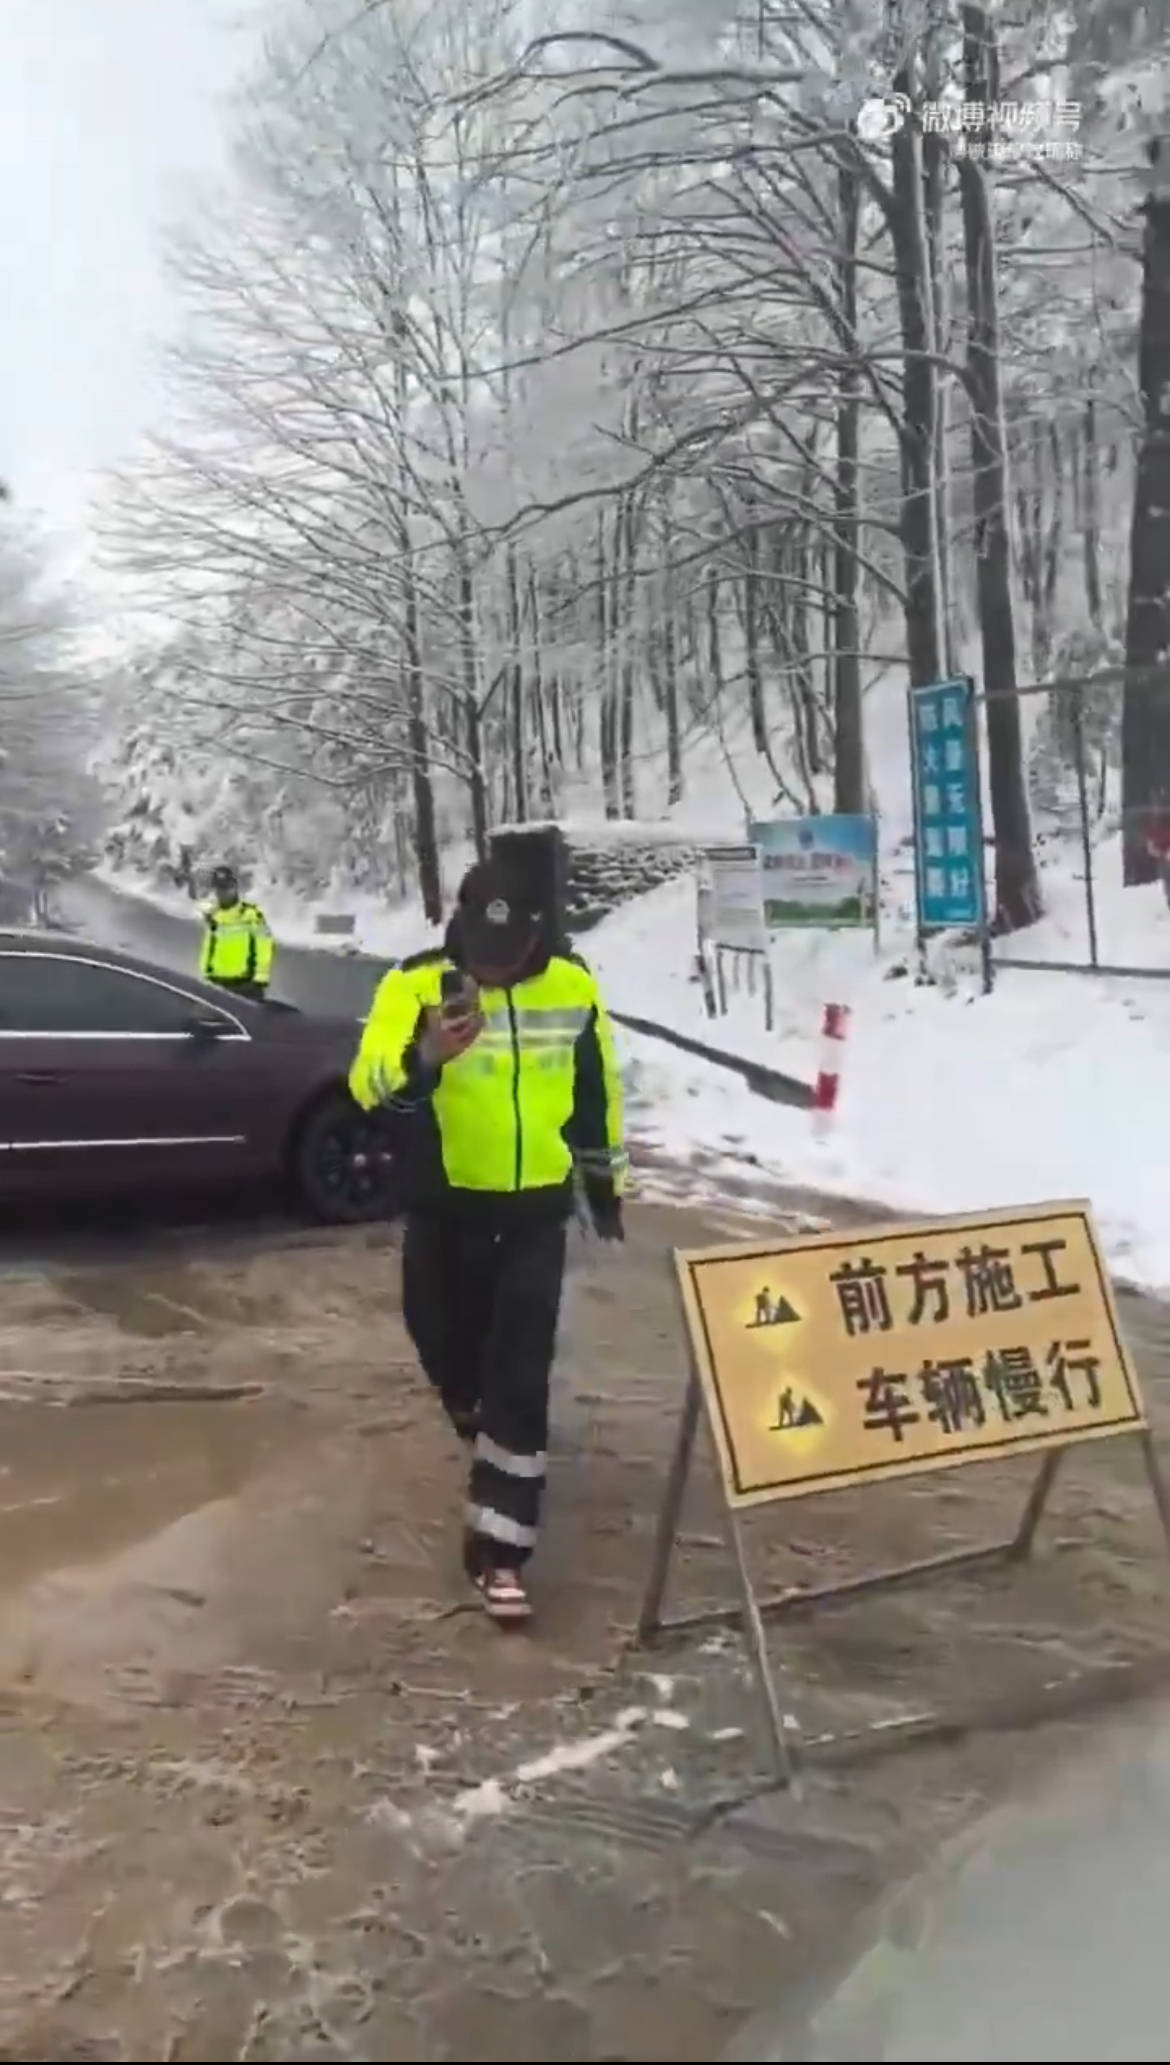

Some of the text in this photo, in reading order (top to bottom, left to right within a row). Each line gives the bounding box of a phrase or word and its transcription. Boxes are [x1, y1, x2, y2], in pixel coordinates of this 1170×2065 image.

[829, 1238, 1081, 1337] 前方施工
[856, 1339, 1101, 1442] 车辆慢行
